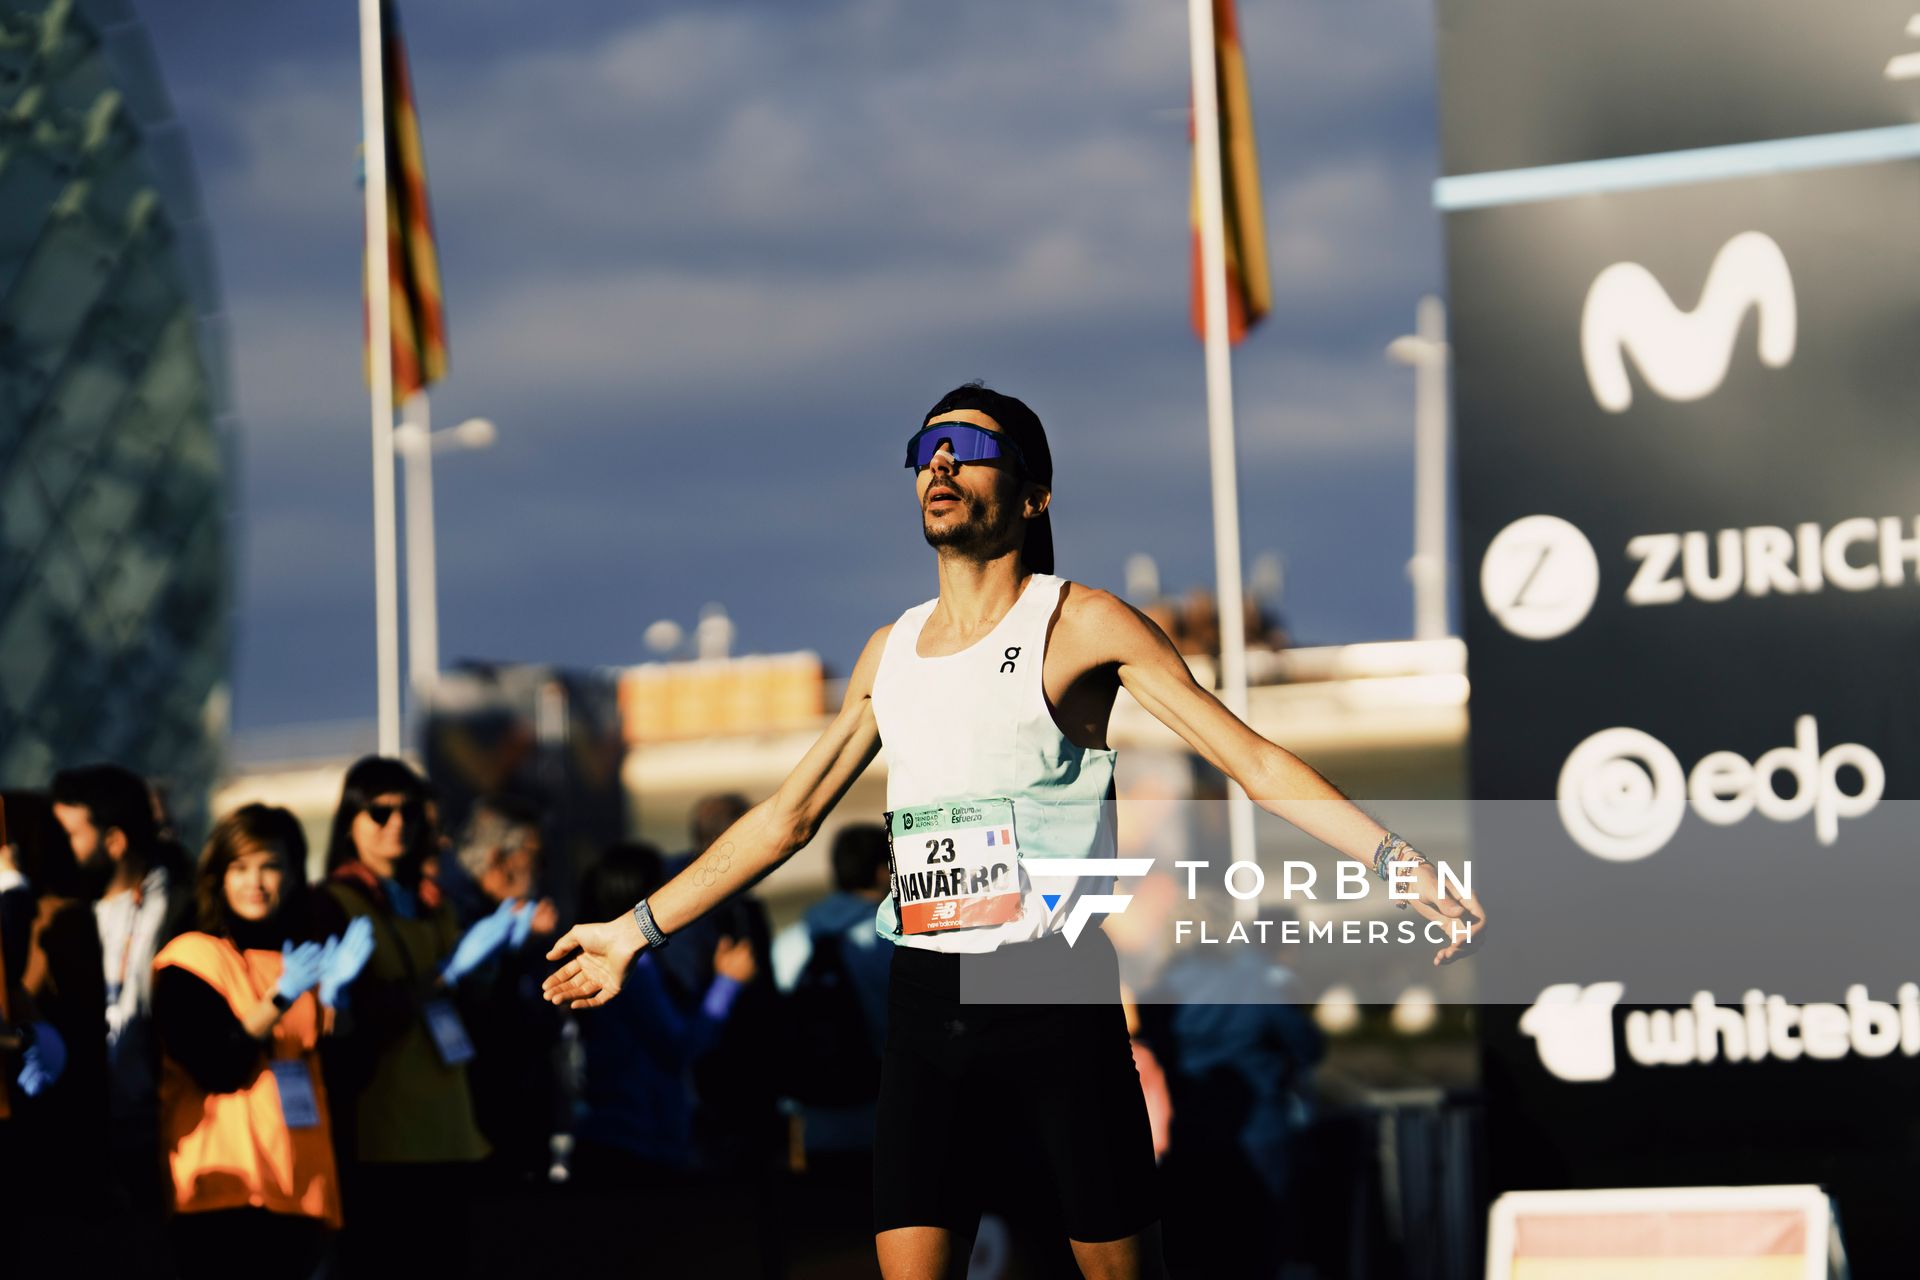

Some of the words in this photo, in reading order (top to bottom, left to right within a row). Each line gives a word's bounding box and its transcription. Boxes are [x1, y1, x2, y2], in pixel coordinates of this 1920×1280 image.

[1626, 514, 1920, 606] ZURICH
[1688, 714, 1885, 845] edp
[951, 807, 974, 816] Cultura
[951, 814, 982, 824] Esfuerzo
[925, 838, 956, 865] 23
